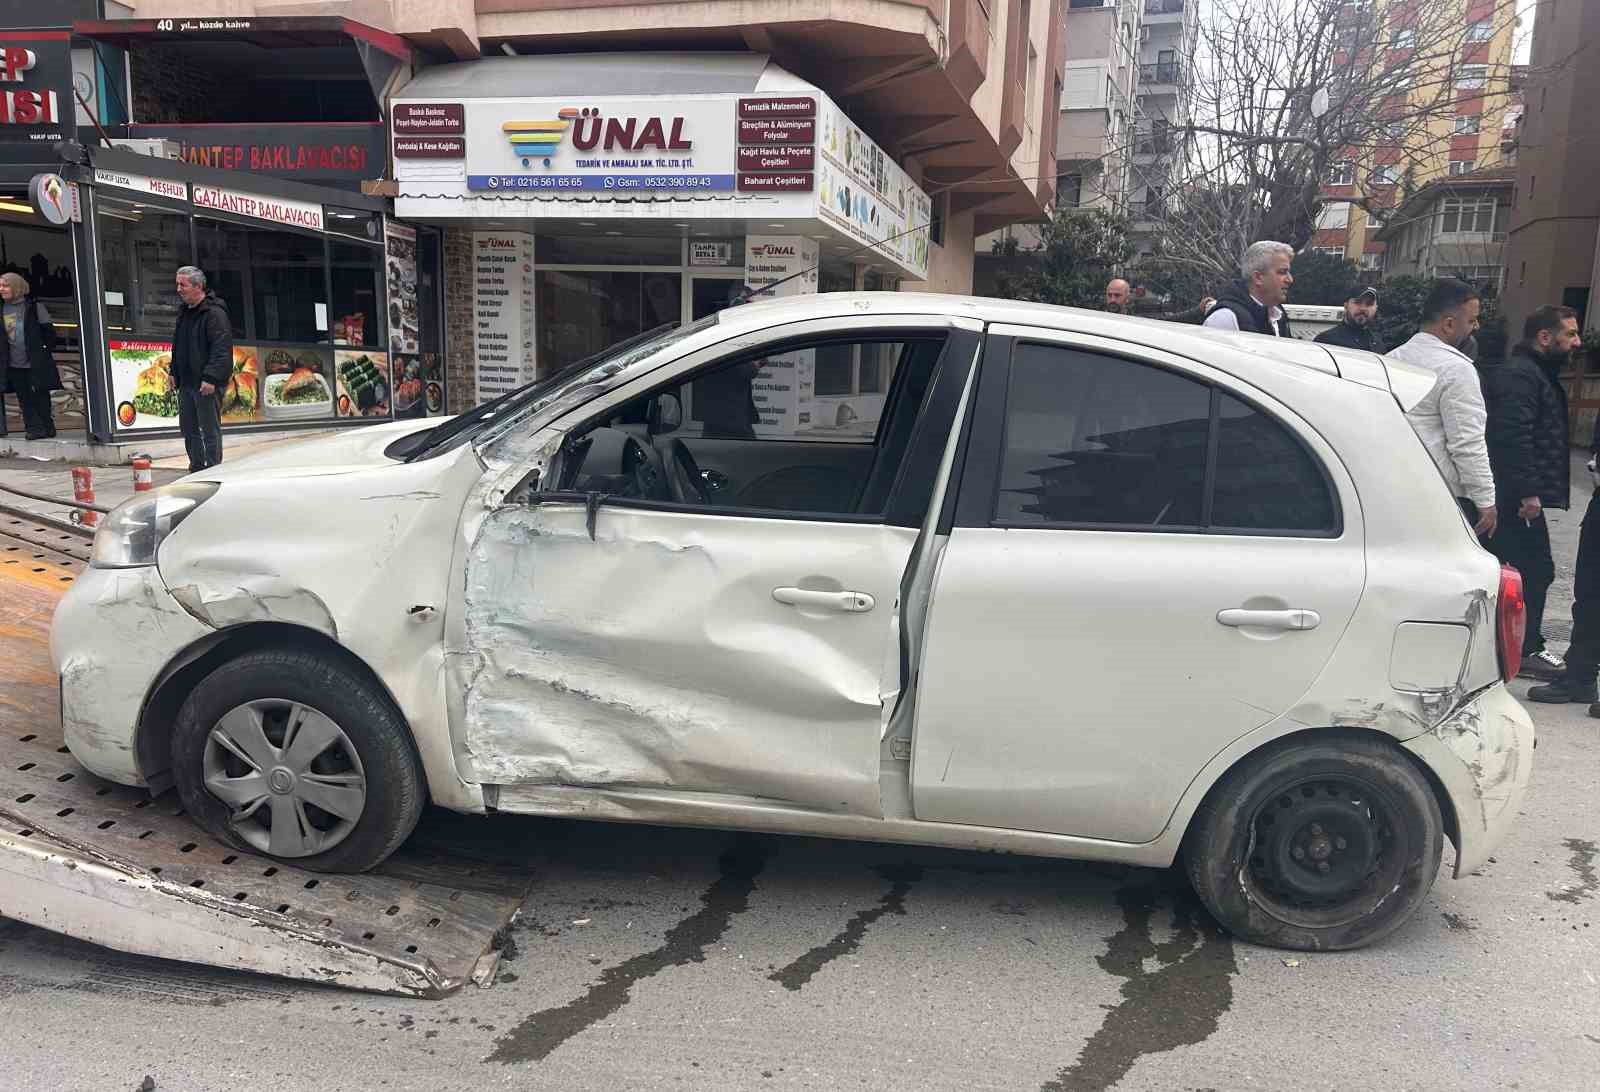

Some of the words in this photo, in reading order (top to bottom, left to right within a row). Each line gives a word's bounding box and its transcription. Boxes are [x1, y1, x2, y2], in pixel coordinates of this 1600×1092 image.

[157, 19, 173, 31] 40
[743, 103, 770, 111] Temizlik
[771, 101, 810, 111] Malzemeleri
[572, 107, 693, 151] ÜNAL
[770, 121, 776, 129] &
[250, 143, 367, 170] BAKLAVACISI
[759, 147, 779, 155] Havlu
[780, 147, 786, 155] &
[787, 147, 811, 157] Peçete
[575, 158, 601, 168] TEDARİK
[602, 159, 610, 168] VE
[611, 159, 639, 168] AMBALAJ
[501, 178, 516, 187] Tel:
[517, 178, 539, 187] 0216
[541, 178, 556, 187] 561
[558, 178, 570, 187] 65
[571, 178, 583, 187] 65
[617, 177, 640, 187] Gsm:
[645, 177, 666, 187] 0532
[668, 177, 685, 187] 390
[686, 177, 698, 187] 89
[699, 177, 711, 187] 43
[744, 177, 774, 185] Baharat
[193, 186, 256, 217] GAZİANTEP
[258, 201, 321, 228] BAKLAVACISI
